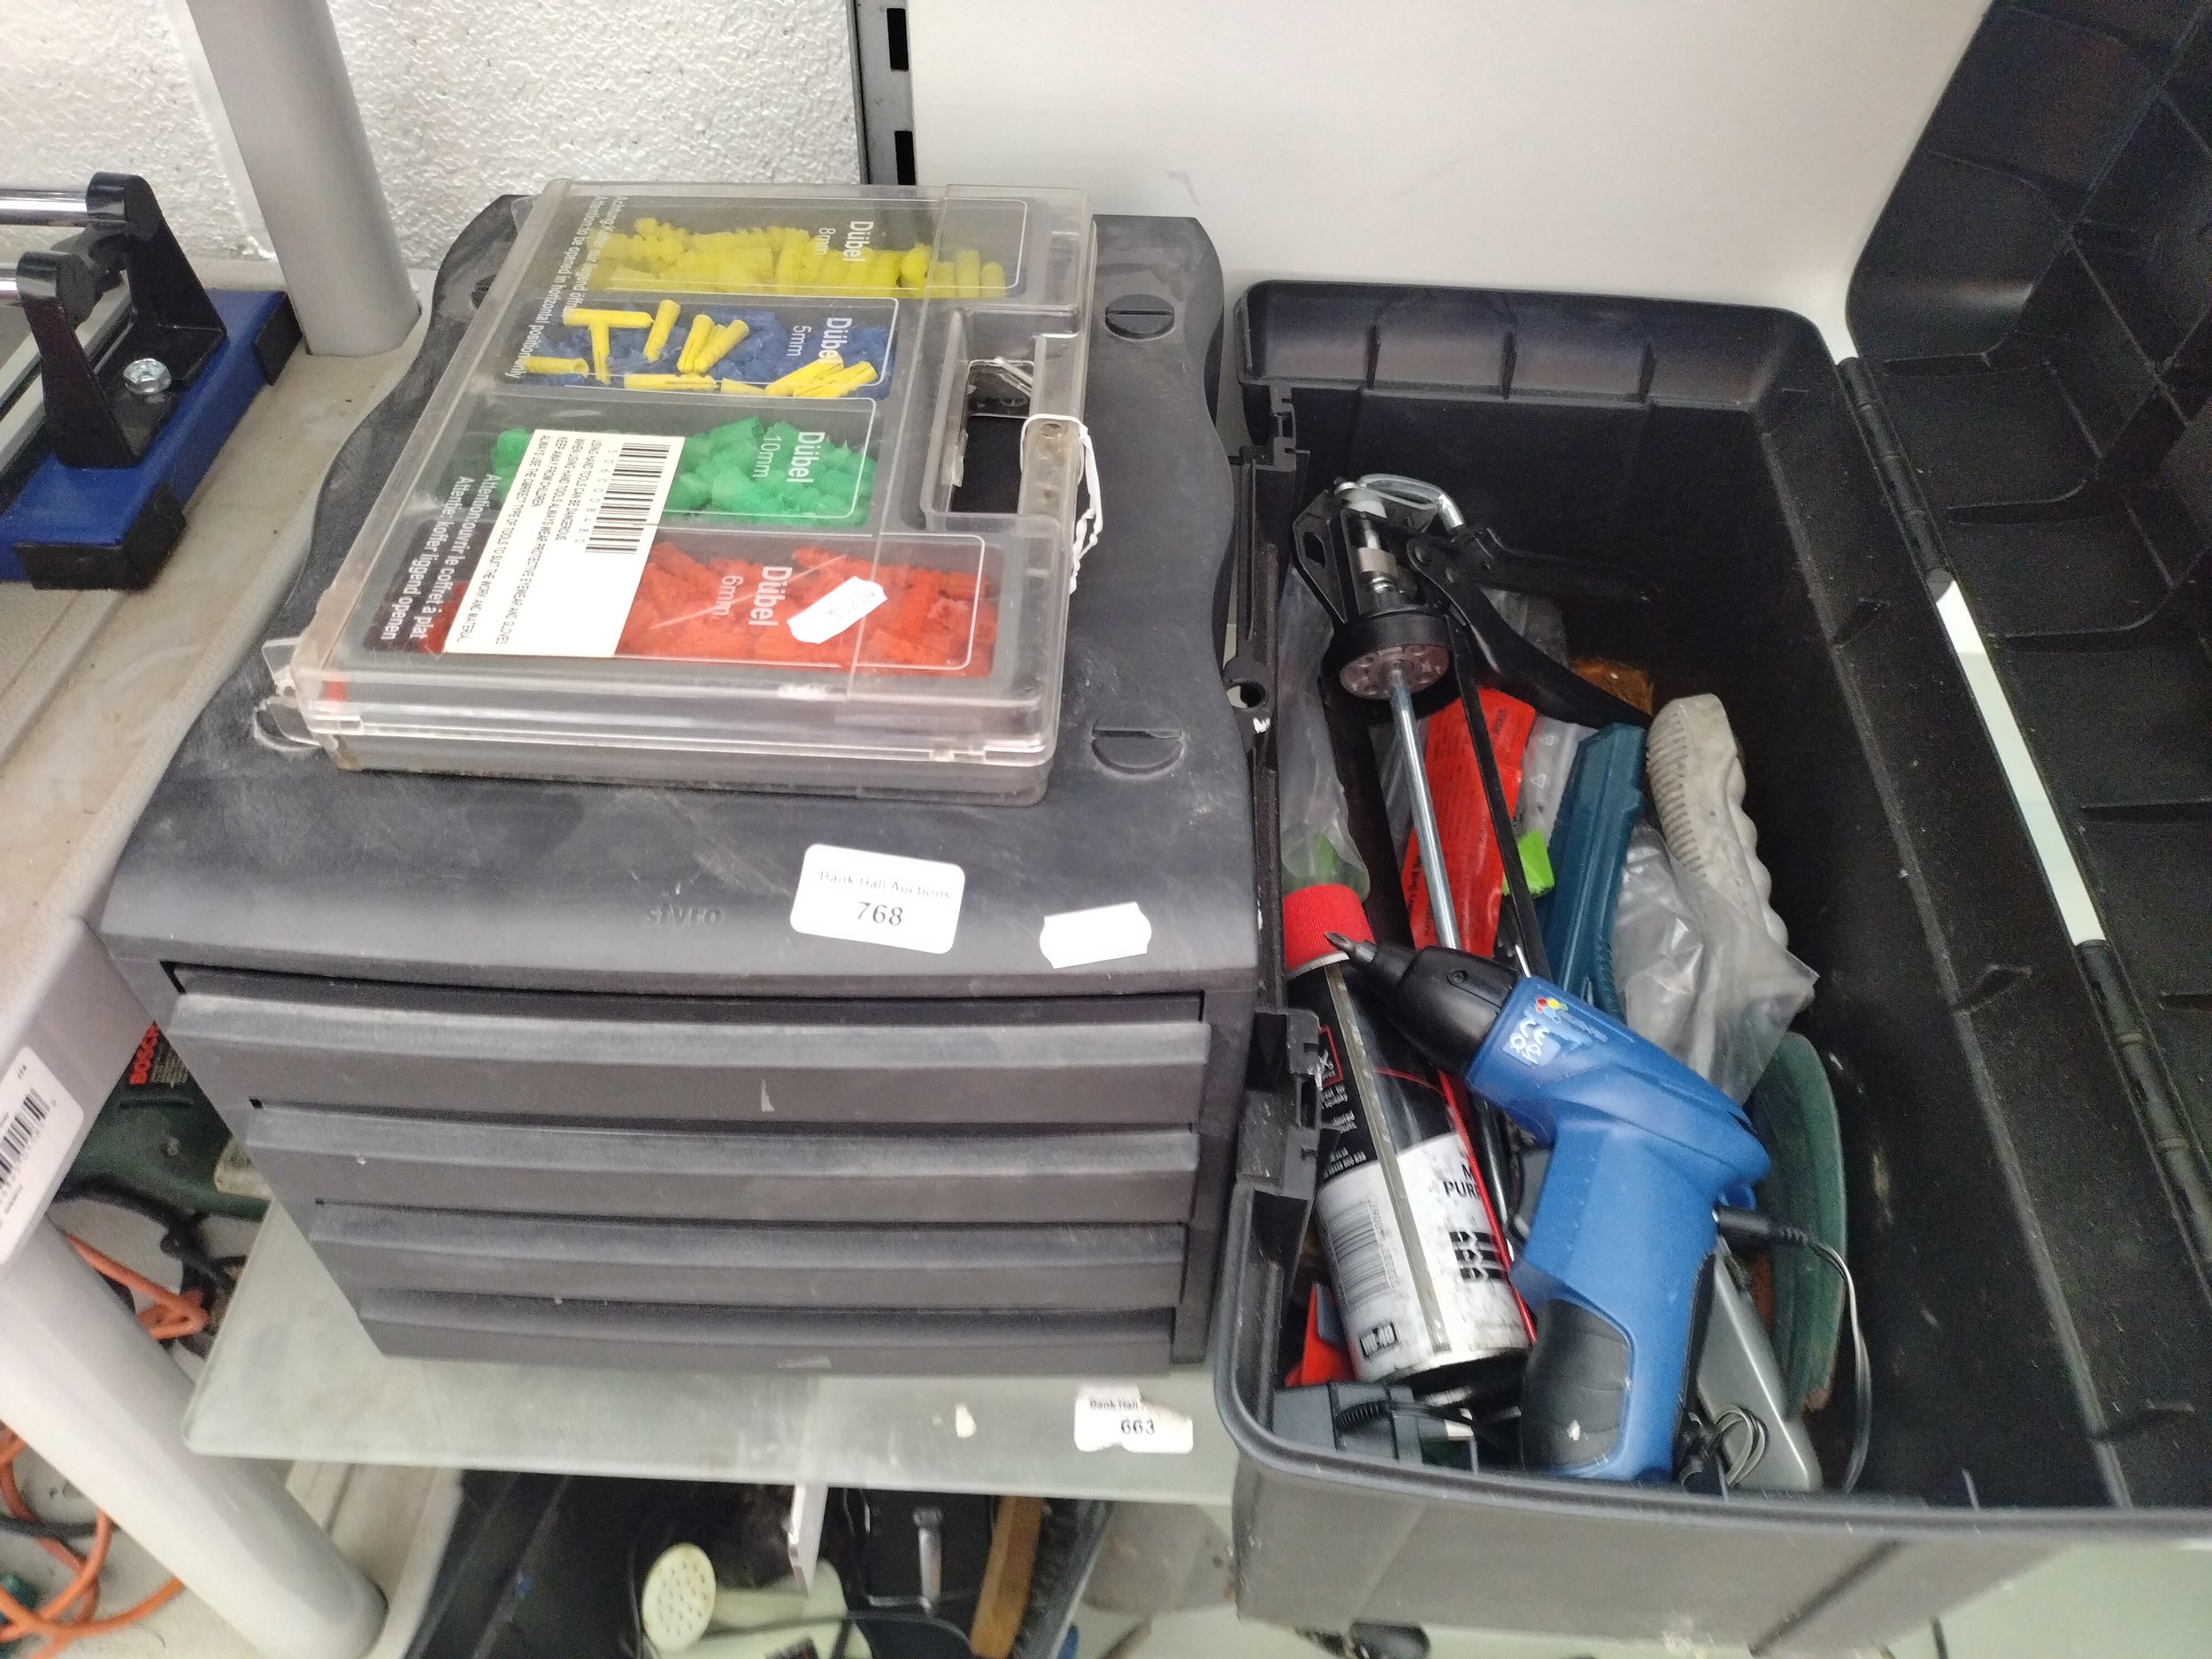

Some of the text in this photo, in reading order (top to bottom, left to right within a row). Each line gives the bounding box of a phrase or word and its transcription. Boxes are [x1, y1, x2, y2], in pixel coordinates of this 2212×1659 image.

[813, 227, 836, 255] 8mm
[842, 221, 874, 261] Dübel
[558, 247, 580, 274] opened
[535, 285, 566, 324] horizontal
[518, 326, 544, 357] position
[787, 326, 812, 356] 5mm
[818, 318, 852, 363] Dübel
[505, 358, 527, 379] only
[534, 435, 551, 456] ALWAYS
[556, 437, 568, 449] KEEP
[588, 439, 602, 454] USING
[531, 457, 542, 466] USE
[550, 451, 563, 465] AWAY
[583, 456, 597, 469] HAND
[752, 435, 782, 478] 10mm
[787, 432, 826, 482] Dübel
[525, 468, 538, 477] THE
[541, 466, 557, 480] FROM
[575, 471, 591, 487] TOOLS
[572, 488, 585, 499] CAN
[507, 504, 524, 518] TYPE
[495, 439, 586, 644] WHEN USING HAND TOOLS ALWAYS WEAR PROTECTIVE EYEWEAR AND GLOVES
[497, 527, 514, 545] TOOLS
[380, 476, 474, 640] Attentie: koffer liggend openen
[444, 556, 465, 565] le
[488, 556, 503, 567] SUIT
[483, 569, 497, 579] THE
[426, 567, 455, 603] coffret
[476, 580, 492, 598] WORK
[711, 576, 743, 615] 6mm
[749, 566, 793, 626] Dübel
[471, 600, 486, 611] AND
[410, 616, 437, 639] plat
[820, 871, 853, 884] Bank
[857, 901, 903, 926] 768
[1089, 1398, 1116, 1410] Bank
[1120, 1417, 1156, 1435] 663
